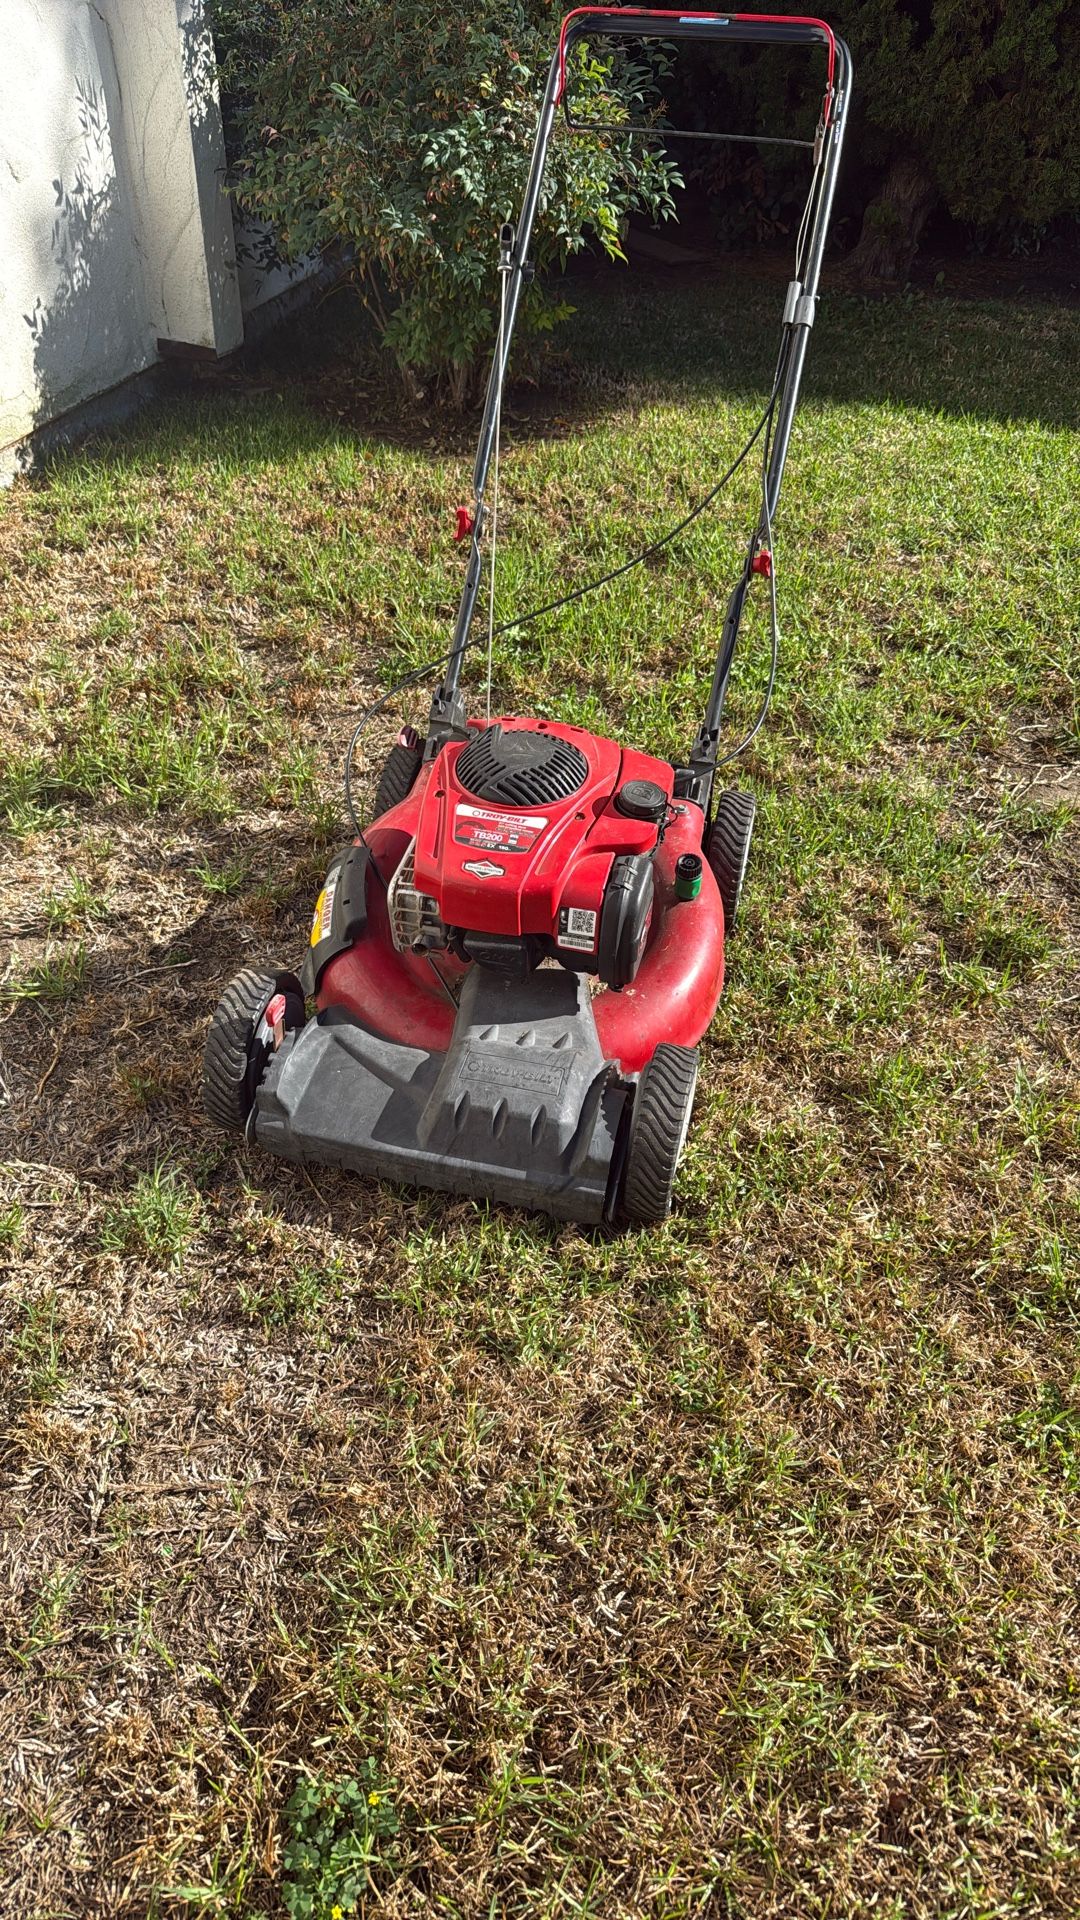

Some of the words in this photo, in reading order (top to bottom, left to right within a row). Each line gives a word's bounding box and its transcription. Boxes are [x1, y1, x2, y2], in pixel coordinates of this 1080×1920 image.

[480, 810, 528, 824] TROY-BILT
[473, 830, 503, 842] TB200
[322, 890, 334, 930] DANGER
